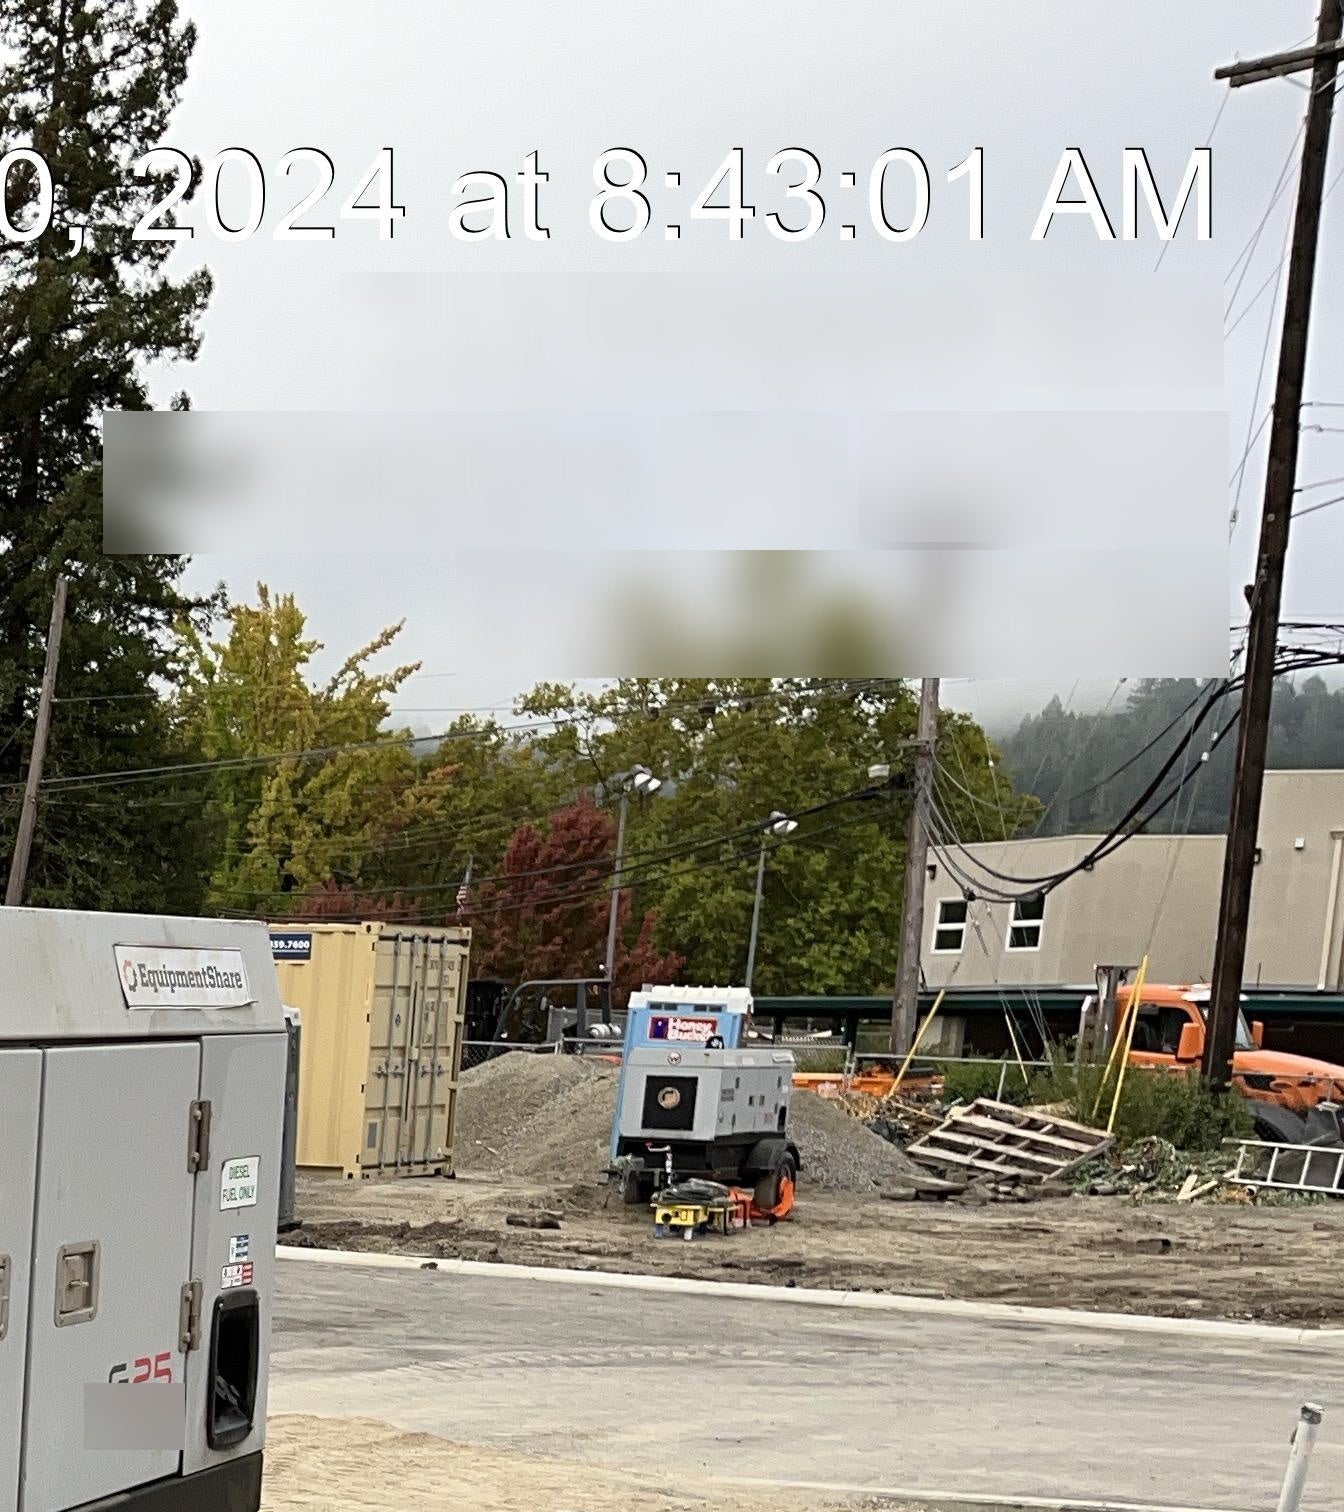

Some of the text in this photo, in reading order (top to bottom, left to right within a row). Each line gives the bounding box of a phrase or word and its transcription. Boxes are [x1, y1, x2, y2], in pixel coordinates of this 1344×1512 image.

[137, 963, 243, 993] EquipmentShare
[229, 1165, 250, 1180] DIESEL
[223, 1185, 255, 1201] FUEL ONLY
